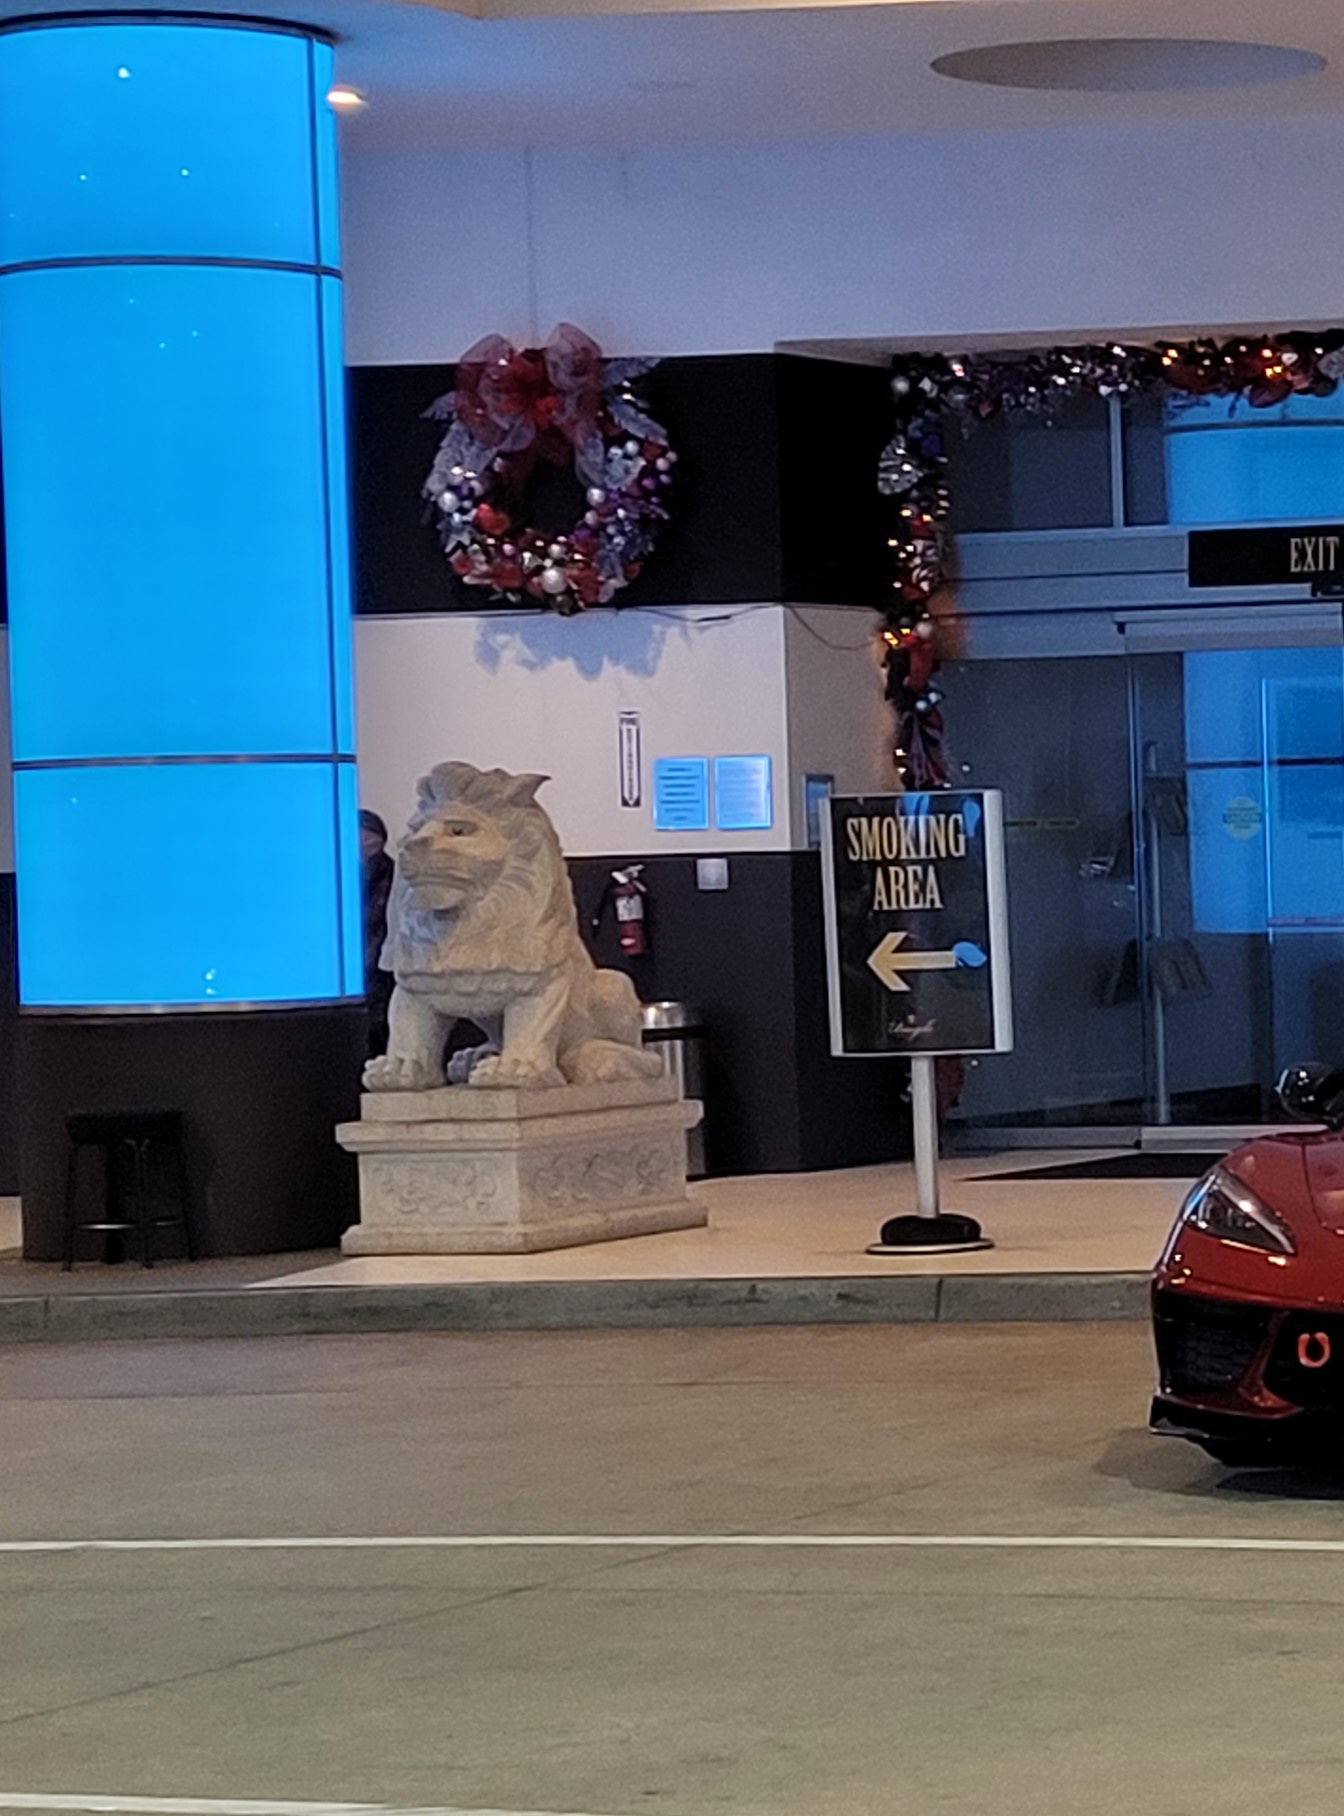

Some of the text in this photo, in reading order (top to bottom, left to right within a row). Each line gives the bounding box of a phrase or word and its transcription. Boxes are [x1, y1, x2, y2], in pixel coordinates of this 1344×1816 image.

[1290, 536, 1340, 573] EXIT
[846, 813, 966, 861] SMOKING
[873, 865, 944, 911] AREA
